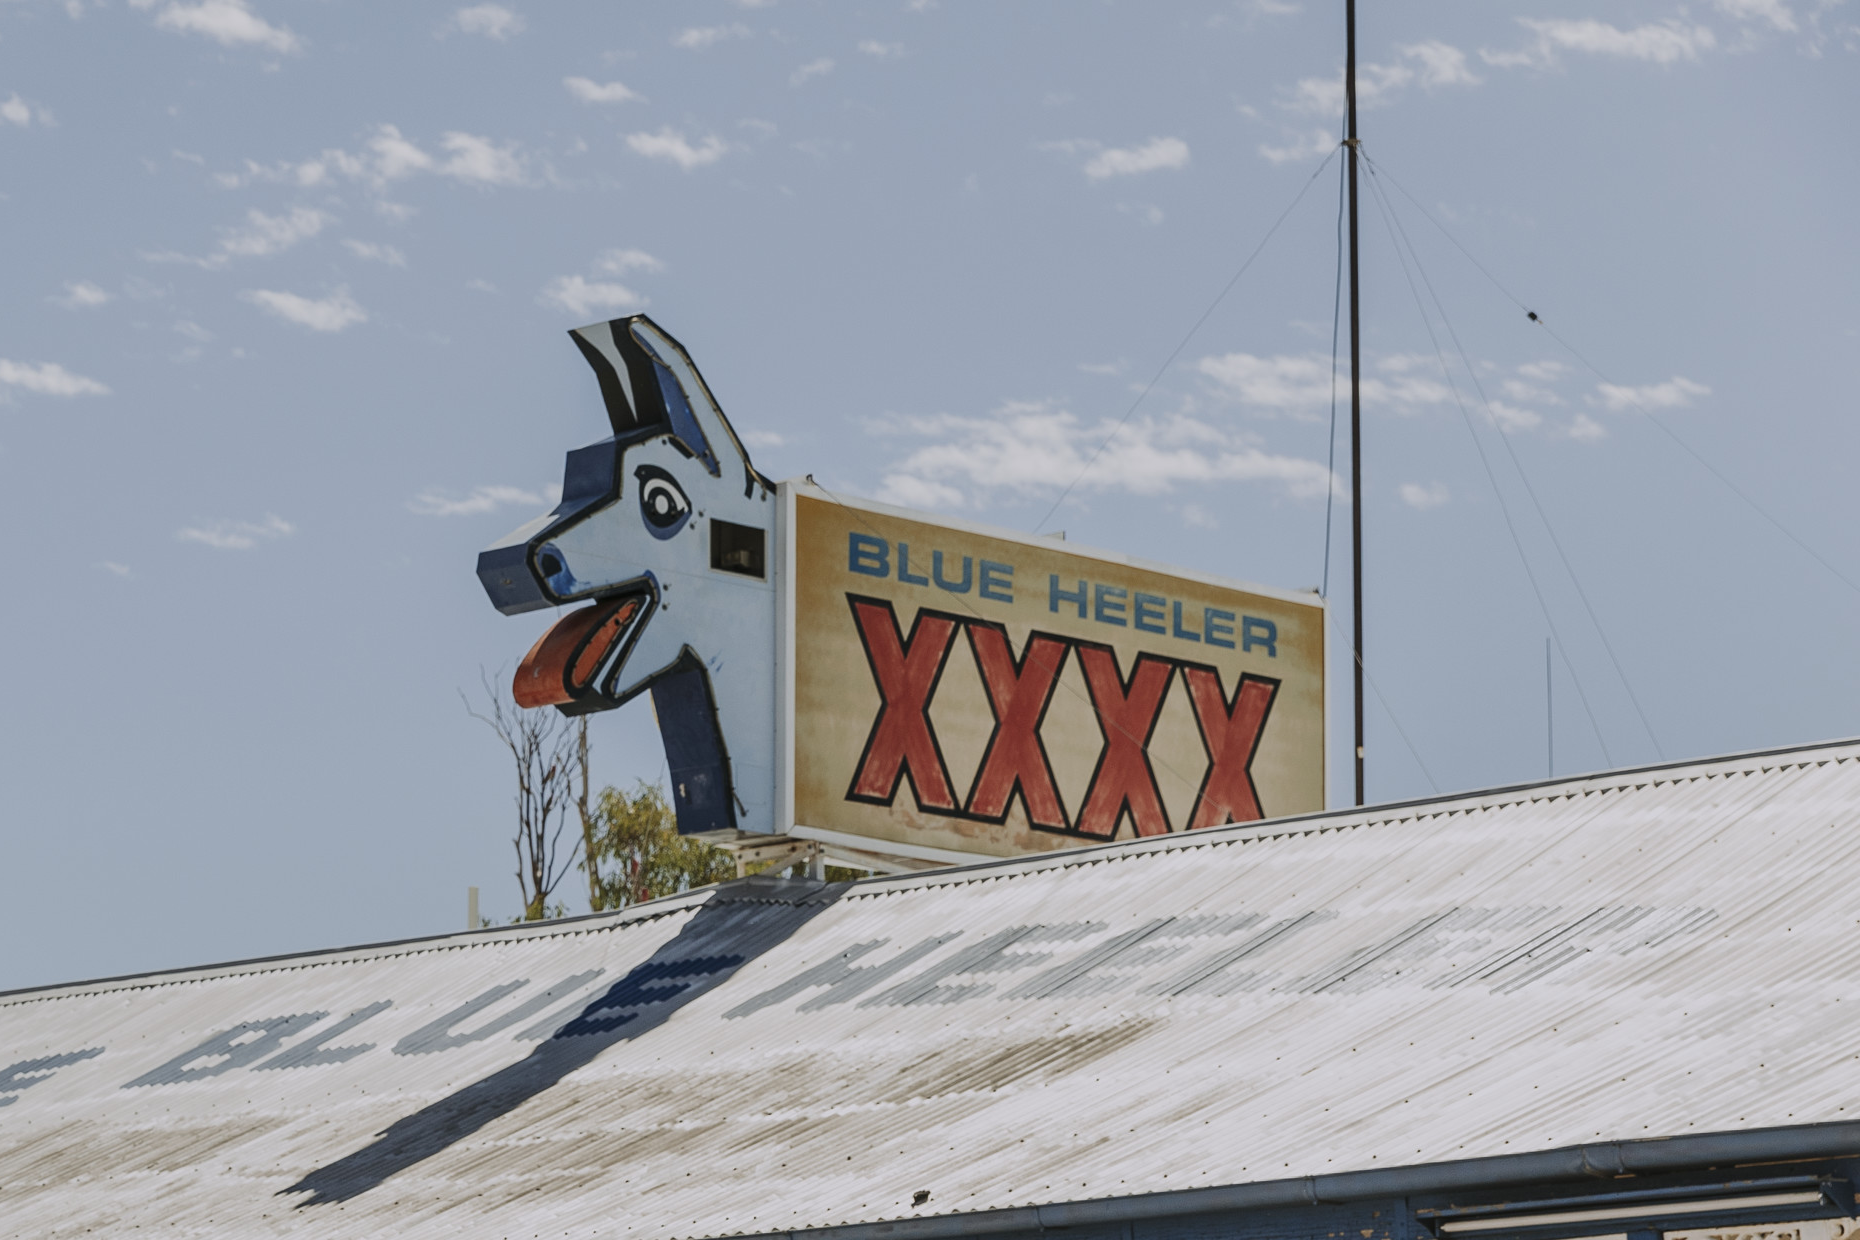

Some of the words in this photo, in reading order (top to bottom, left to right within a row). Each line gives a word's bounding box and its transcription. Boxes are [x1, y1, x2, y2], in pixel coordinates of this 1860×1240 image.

[848, 532, 1014, 604] BLUE
[1049, 574, 1278, 658] HEELER
[845, 592, 1282, 842] XXXX
[120, 954, 745, 1090] BLUE
